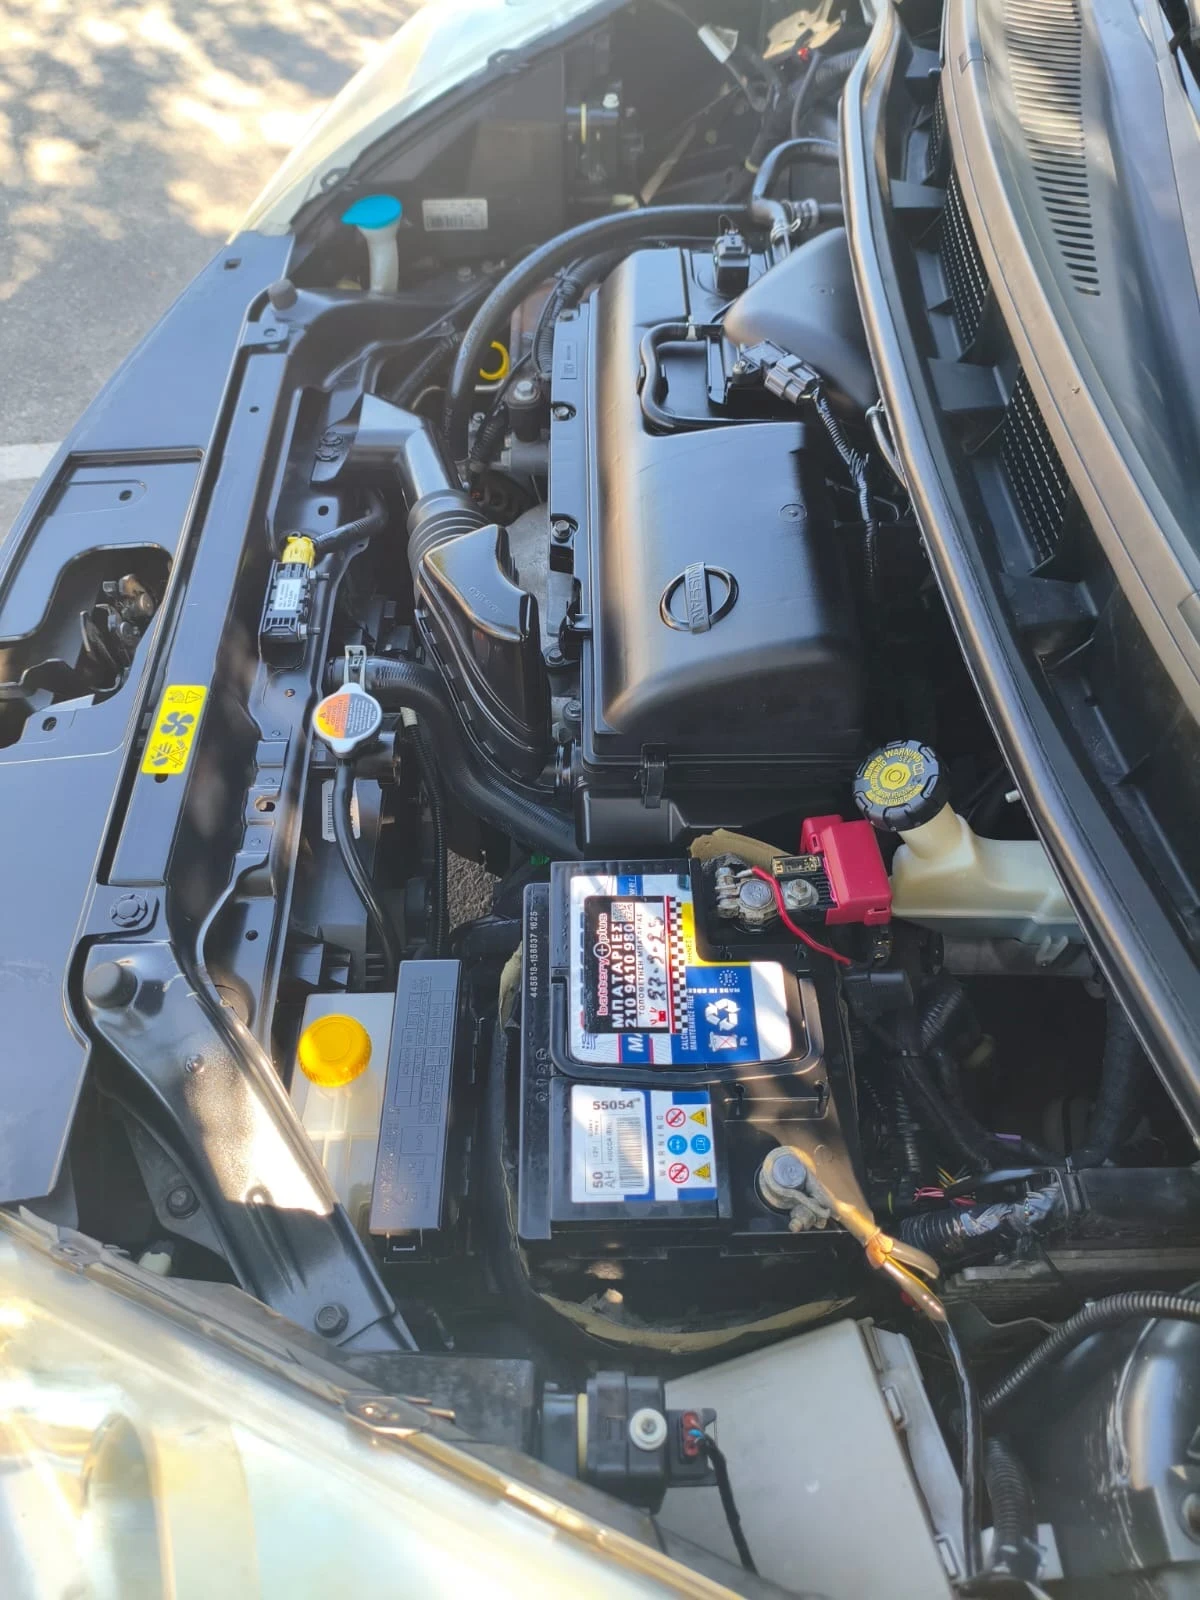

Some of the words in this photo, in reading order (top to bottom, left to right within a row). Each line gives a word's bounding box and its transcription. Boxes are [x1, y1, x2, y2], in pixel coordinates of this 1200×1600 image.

[686, 566, 705, 625] NISSAN
[884, 748, 924, 764] WARNING
[623, 923, 636, 951] 980
[611, 922, 625, 1028] ΜΠΑΤΑΡΙΕΣ
[624, 954, 636, 993] 9410
[624, 997, 636, 1028] 210
[592, 1100, 635, 1111] 55054
[656, 1114, 667, 1177] WARNING
[592, 1171, 604, 1188] 50
